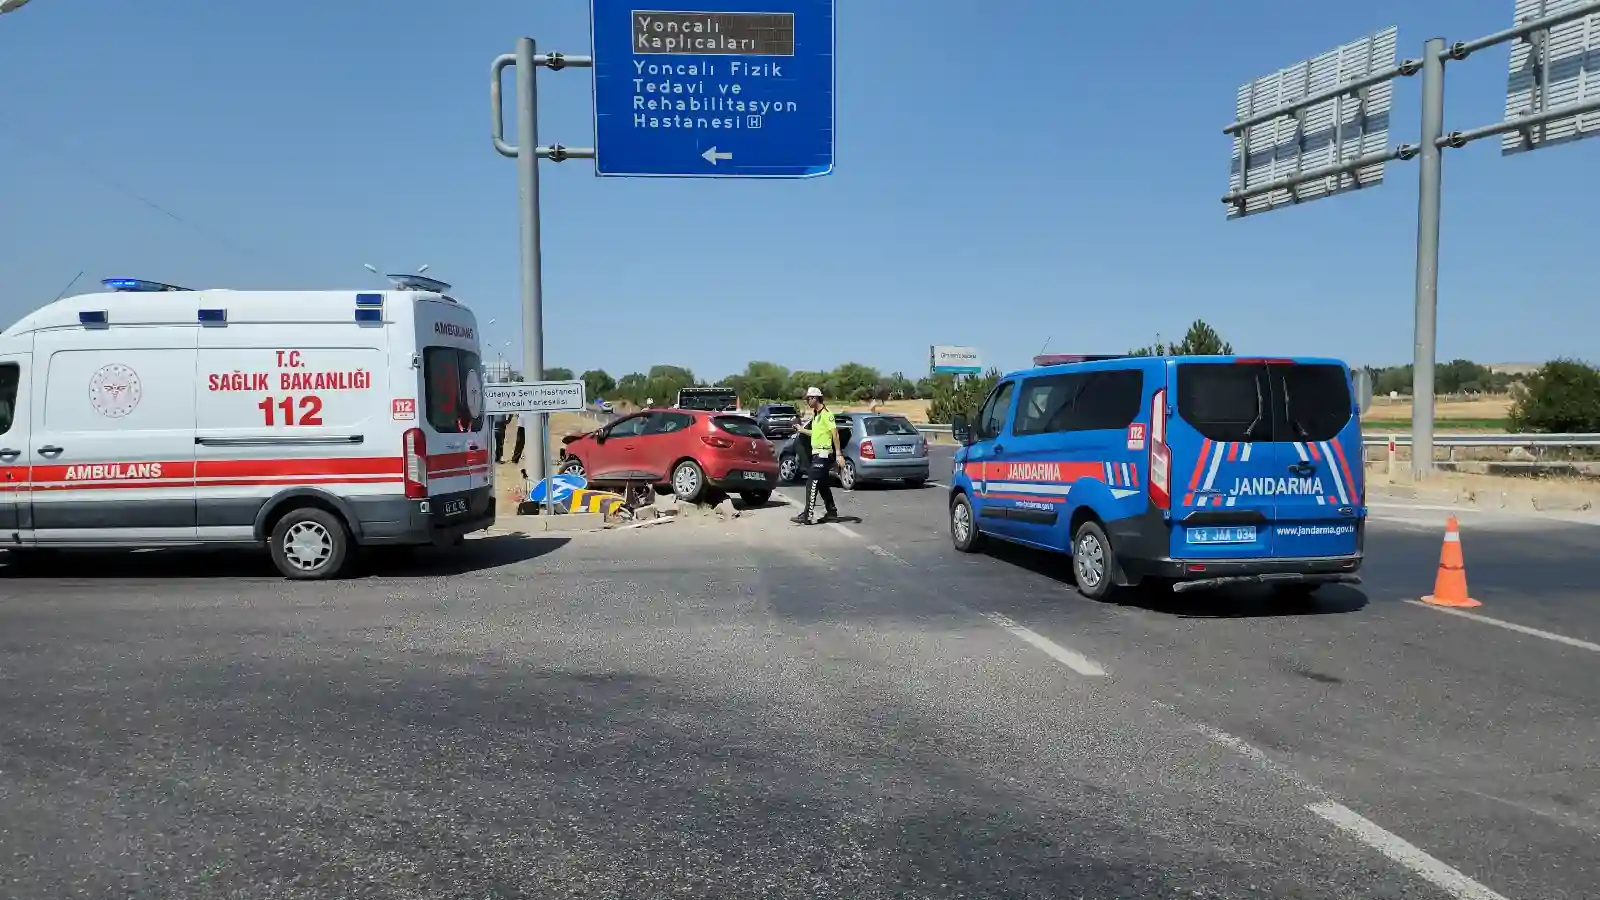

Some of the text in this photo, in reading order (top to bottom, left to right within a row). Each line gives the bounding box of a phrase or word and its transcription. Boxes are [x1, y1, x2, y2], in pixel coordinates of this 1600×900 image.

[638, 17, 720, 33] Yoncalı
[638, 34, 755, 52] Kaplıcaları
[633, 60, 782, 77] Yoncalı Fizik
[633, 79, 742, 94] Tedavi ve
[633, 96, 797, 115] Rehabilitasyon
[634, 114, 740, 129] Hastanesi
[276, 350, 305, 368] T.C.
[208, 367, 370, 391] SAĞLIK BAKANLIĞI
[258, 396, 323, 426] 112
[395, 400, 413, 412] 112
[1131, 426, 1143, 439] 112
[65, 462, 162, 480] AMBULANS
[1007, 463, 1062, 481] JANDARMA
[1229, 477, 1324, 496] JANDARMA
[1194, 529, 1207, 541] 43
[1277, 525, 1355, 536] www.jandarma.gov.tr
